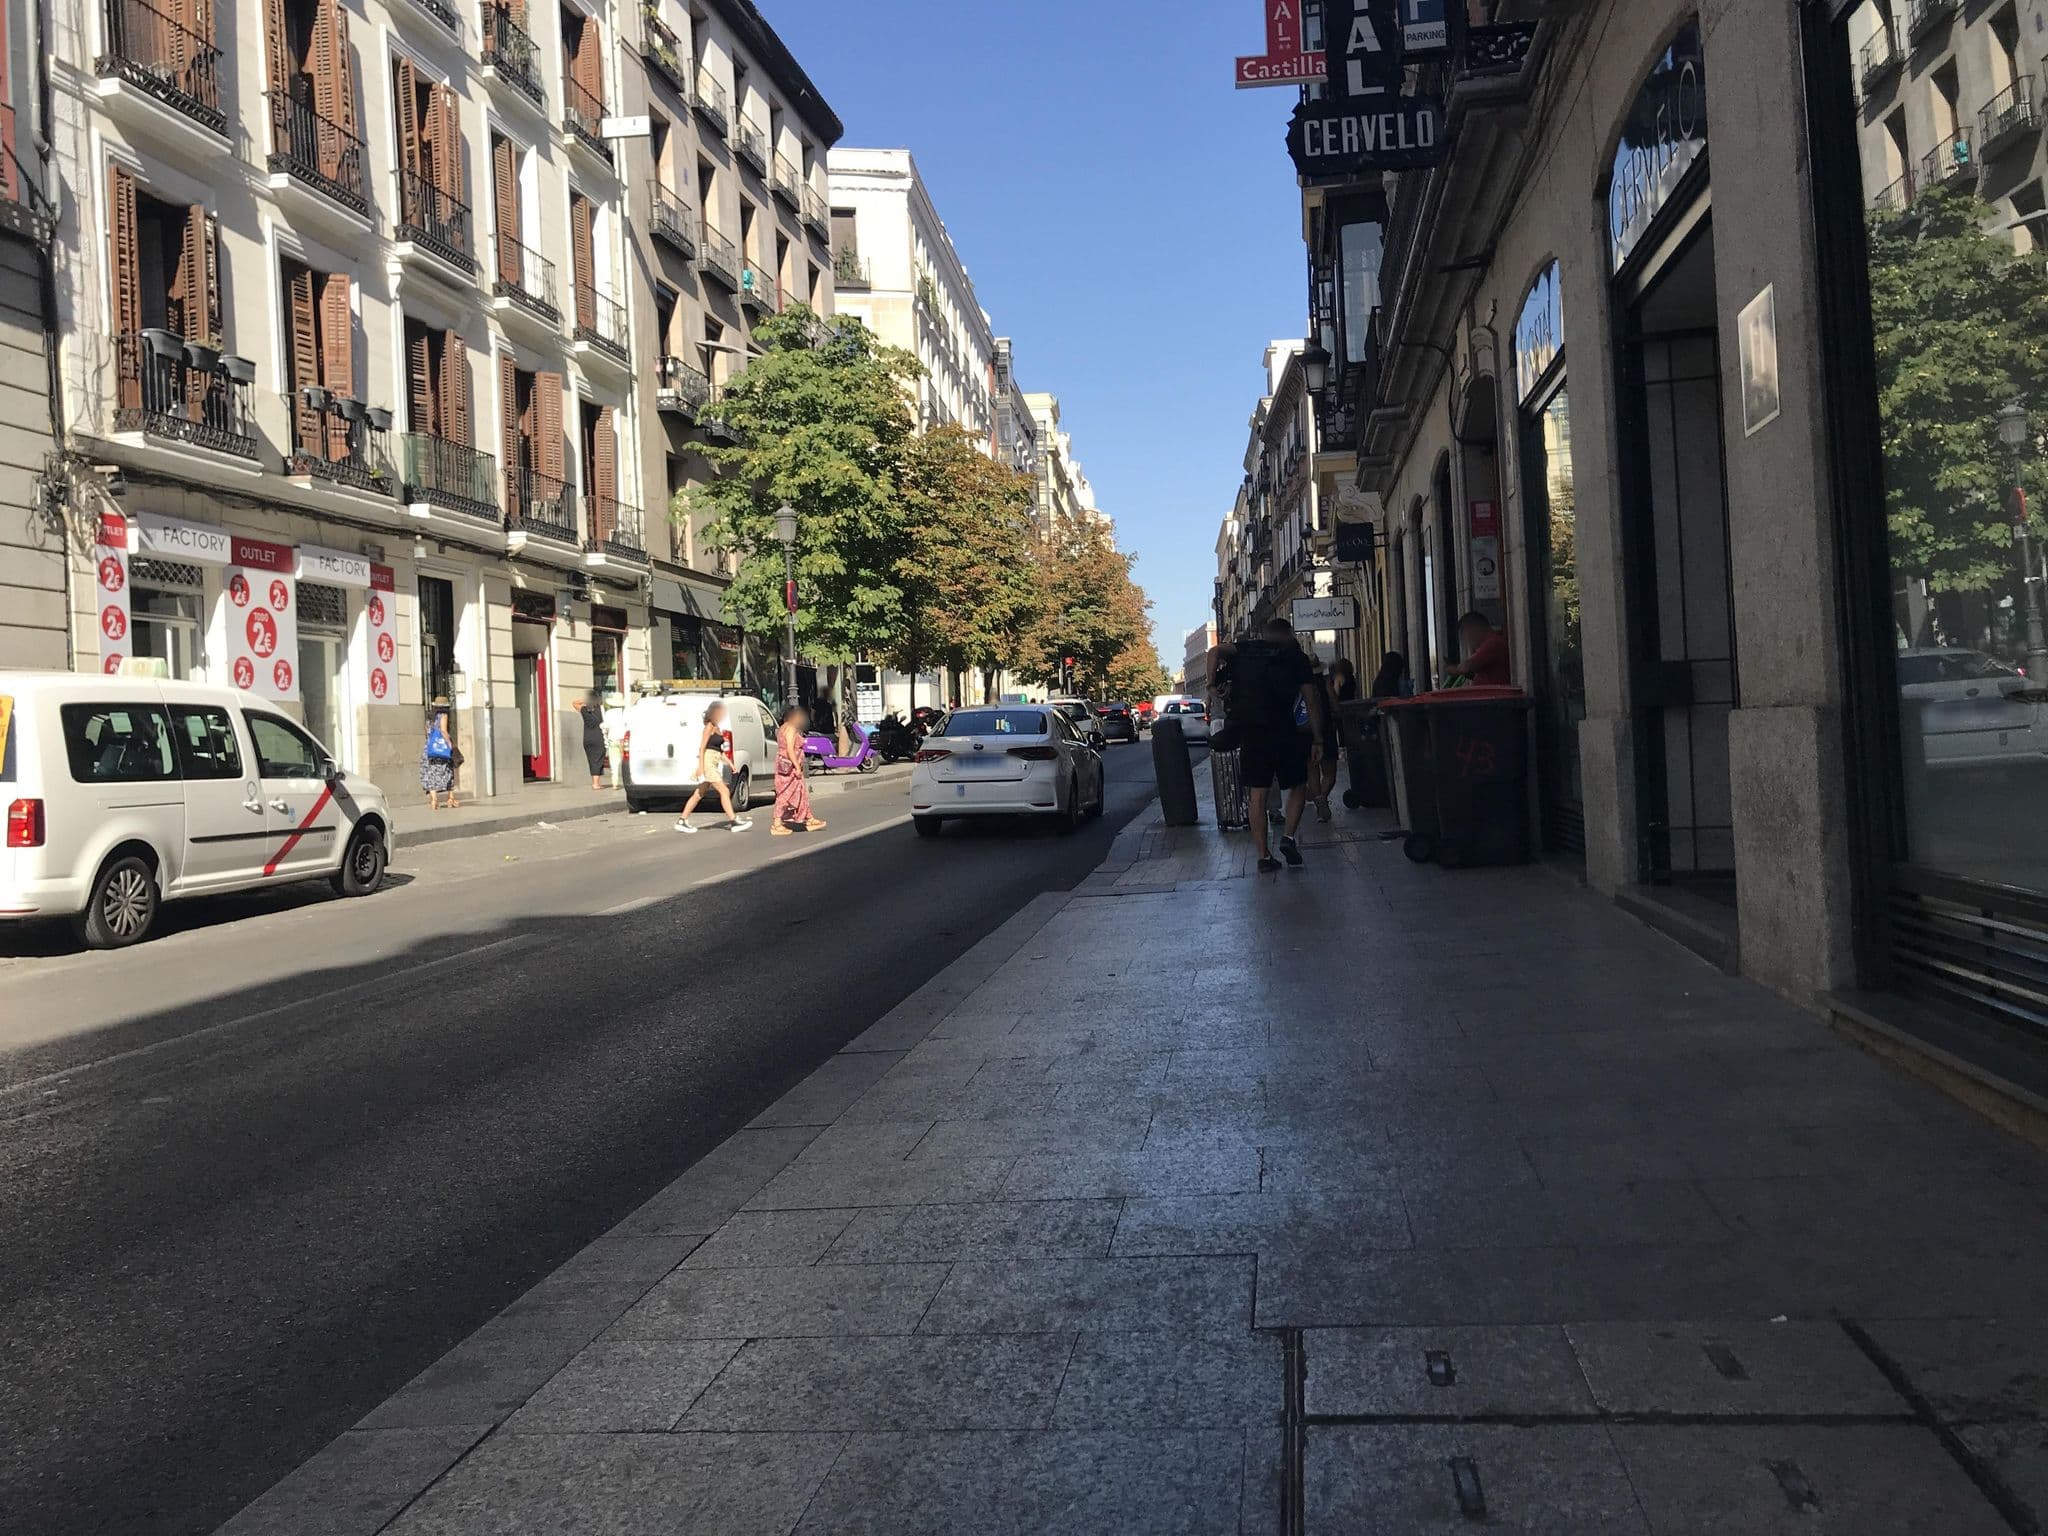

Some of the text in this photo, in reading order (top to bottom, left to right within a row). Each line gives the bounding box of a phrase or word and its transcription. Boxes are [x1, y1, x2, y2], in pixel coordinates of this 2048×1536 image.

[1406, 29, 1445, 42] PARKING
[1346, 0, 1384, 97] AL
[1243, 55, 1327, 79] Castilla
[1303, 110, 1434, 157] CERVELO
[1608, 60, 1697, 244] CERVELO
[163, 526, 226, 551] FACTORY
[240, 546, 277, 563] OUTLET
[319, 555, 367, 577] FACTORY
[105, 566, 121, 589] 2€
[234, 583, 247, 604] 2€
[273, 588, 286, 609] 2€
[107, 614, 123, 638] 2€
[252, 612, 269, 622] TODO
[252, 621, 272, 653] 2€
[381, 641, 391, 660] 2€
[238, 665, 251, 687] 2€
[277, 668, 289, 688] 2€
[374, 676, 385, 696] 2€
